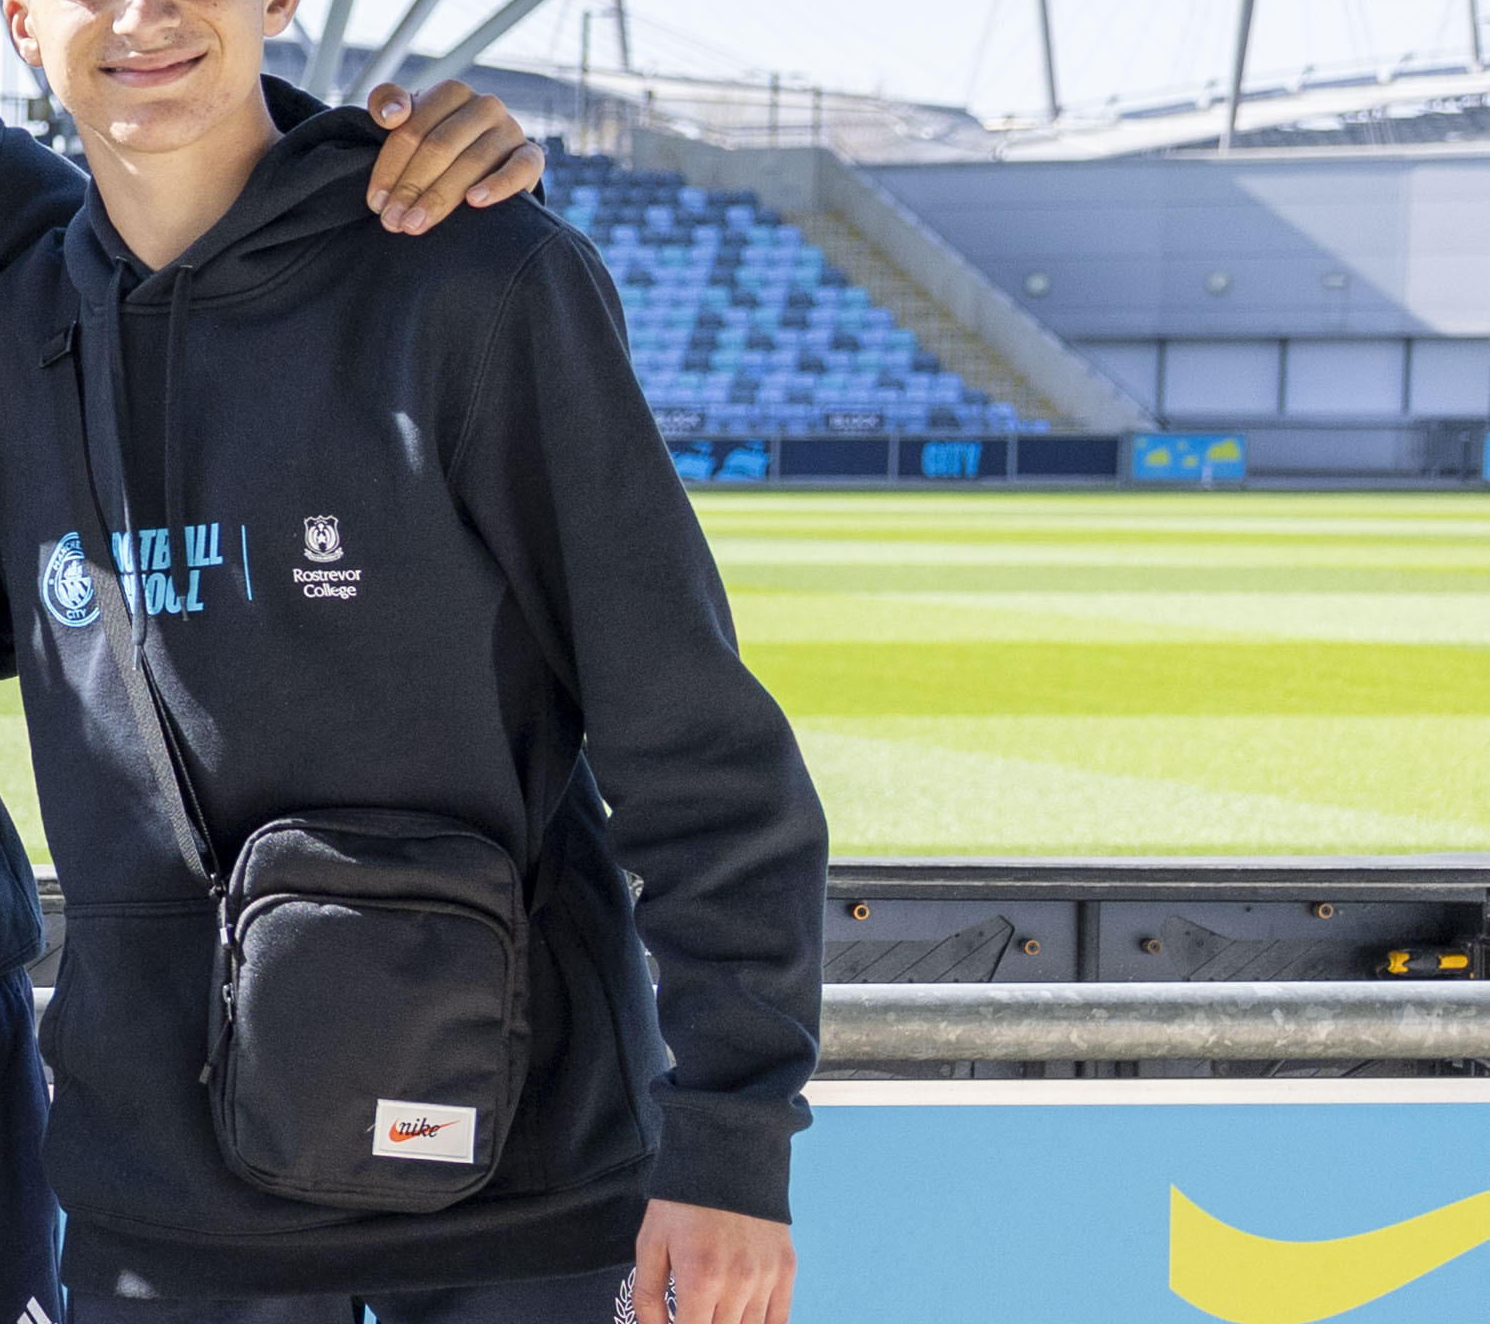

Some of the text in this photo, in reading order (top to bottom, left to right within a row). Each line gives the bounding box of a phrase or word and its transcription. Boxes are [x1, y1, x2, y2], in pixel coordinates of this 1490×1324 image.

[293, 568, 362, 583] Rostrevor
[303, 583, 357, 599] College
[66, 608, 88, 620] CITY
[399, 1117, 441, 1138] nike
